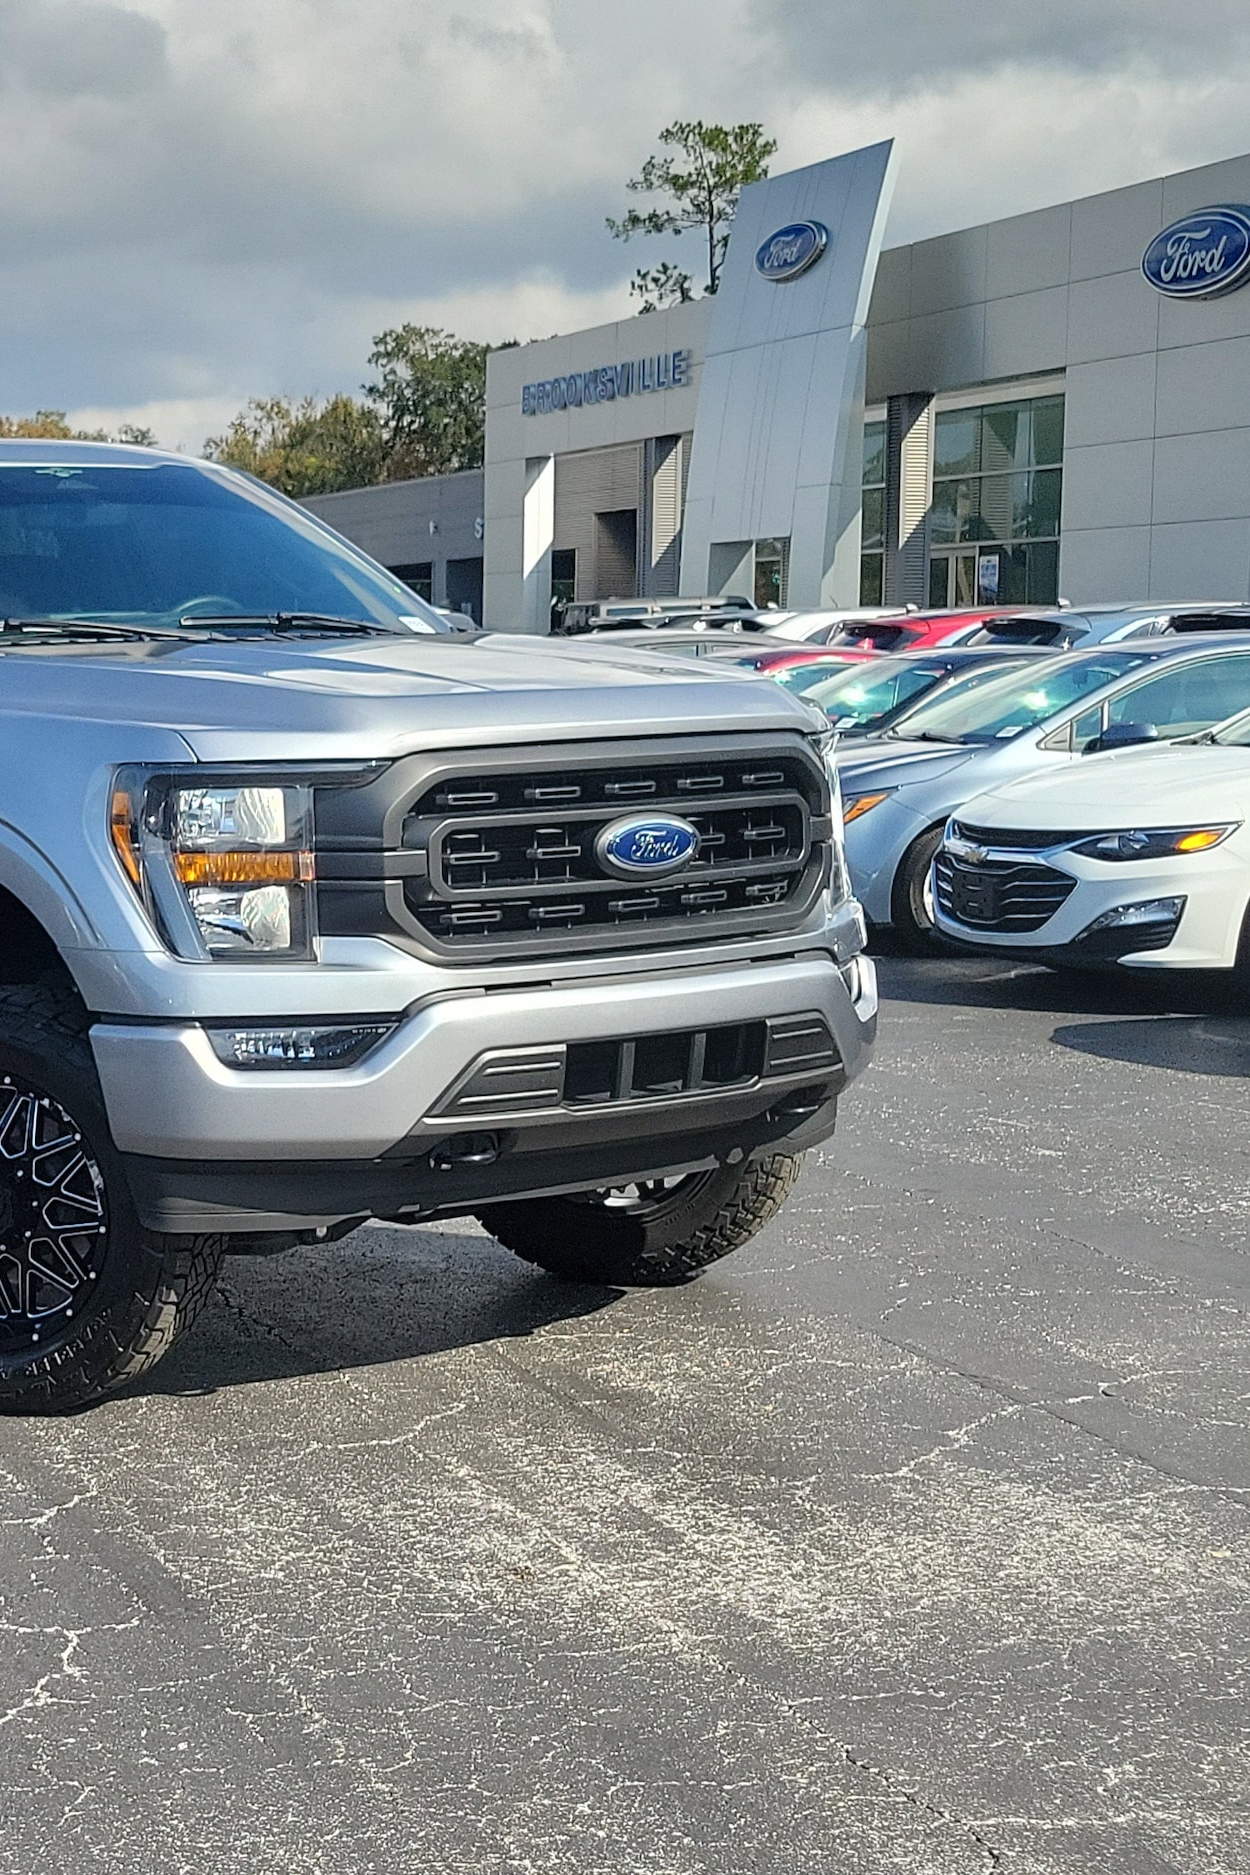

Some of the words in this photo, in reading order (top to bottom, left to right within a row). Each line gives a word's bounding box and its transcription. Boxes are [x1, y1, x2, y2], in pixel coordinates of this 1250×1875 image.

[764, 234, 802, 269] Ford
[1160, 227, 1227, 282] Ford
[521, 350, 690, 416] BROOKSVILLE
[631, 830, 680, 860] Ford
